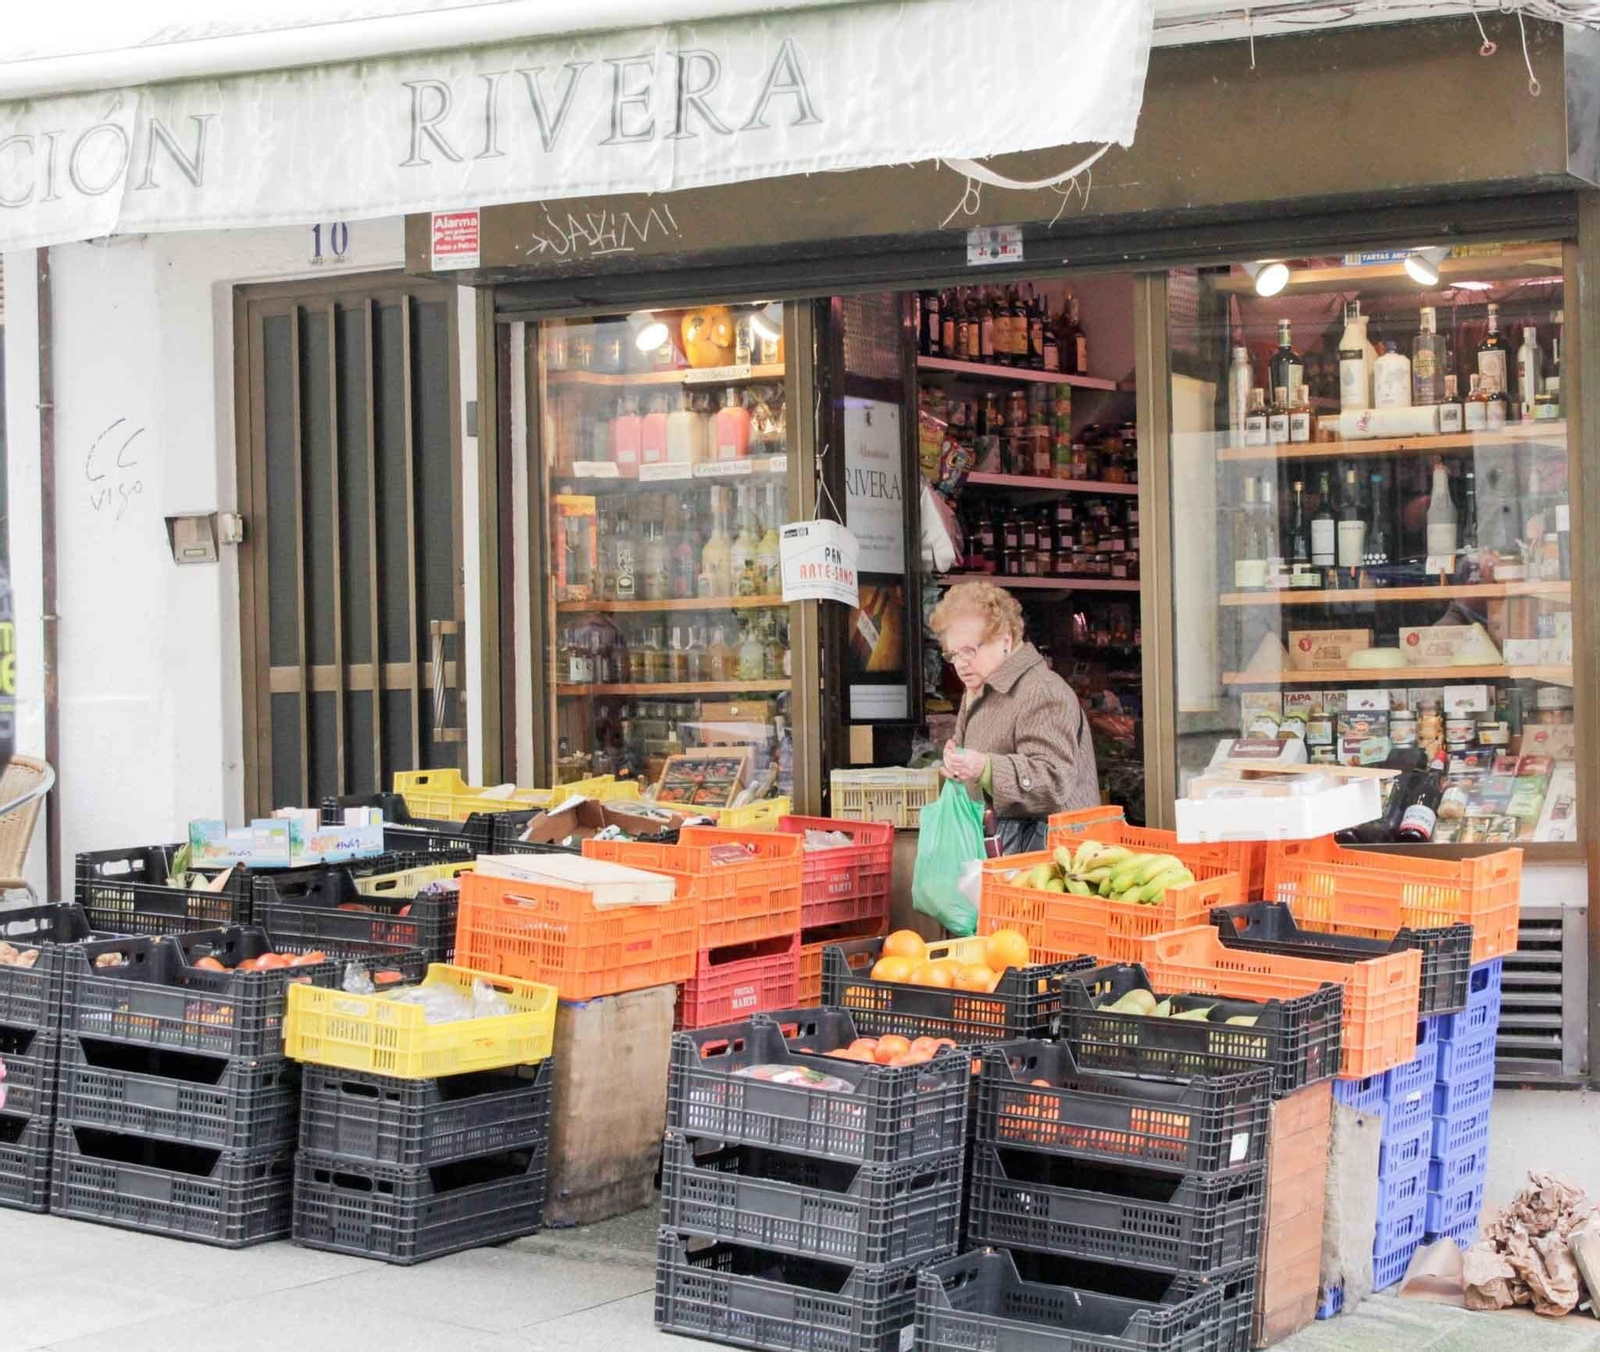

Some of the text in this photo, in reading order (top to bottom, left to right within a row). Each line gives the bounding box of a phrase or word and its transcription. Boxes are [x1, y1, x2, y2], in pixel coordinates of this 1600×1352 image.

[398, 38, 823, 168] RIVERA
[434, 216, 478, 229] Alarma
[311, 222, 348, 257] 10
[1362, 253, 1390, 261] TARTAS
[845, 467, 901, 500] RIVERA
[824, 546, 842, 564] PAN
[1285, 693, 1312, 702] TAPA
